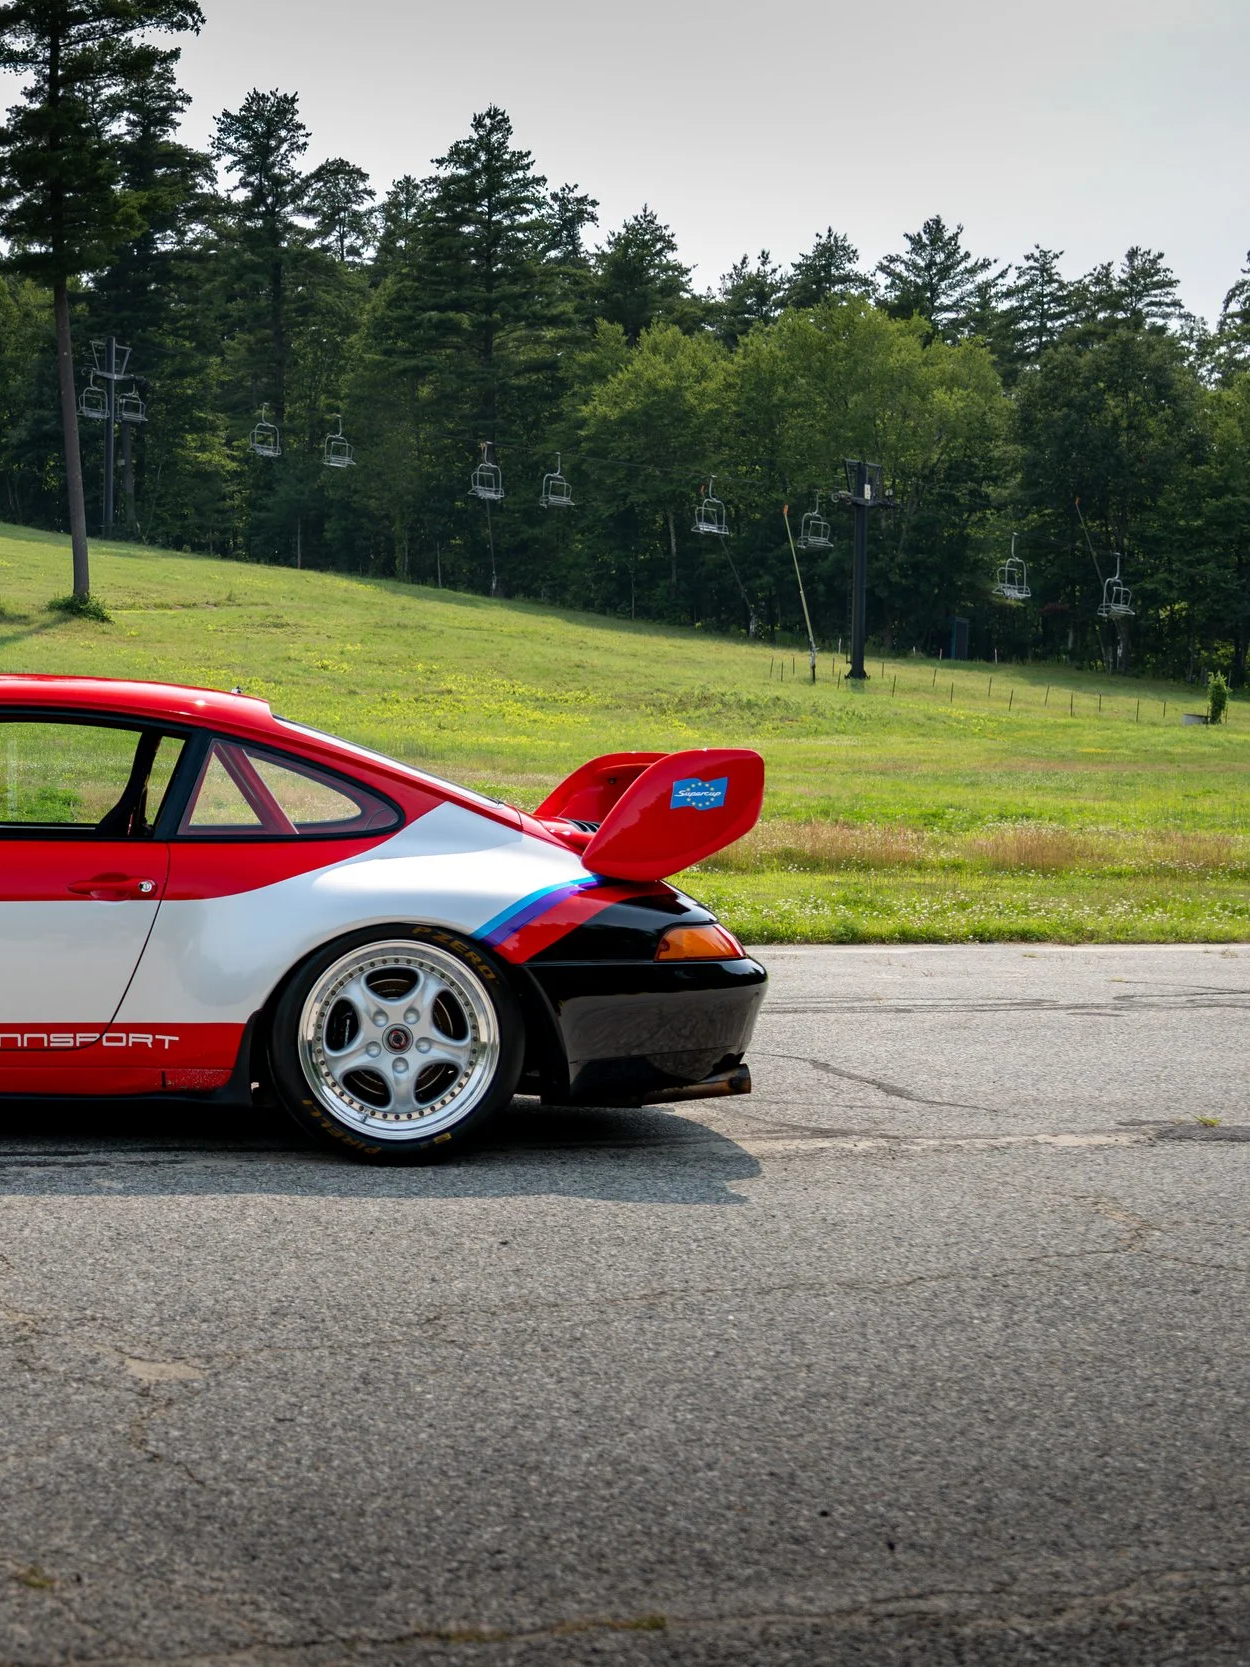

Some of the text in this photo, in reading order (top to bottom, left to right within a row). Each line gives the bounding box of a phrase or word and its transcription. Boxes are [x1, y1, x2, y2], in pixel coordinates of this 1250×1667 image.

[674, 789, 721, 797] Supercup
[412, 926, 497, 979] P ZERO
[302, 1099, 382, 1154] PIRELLI
